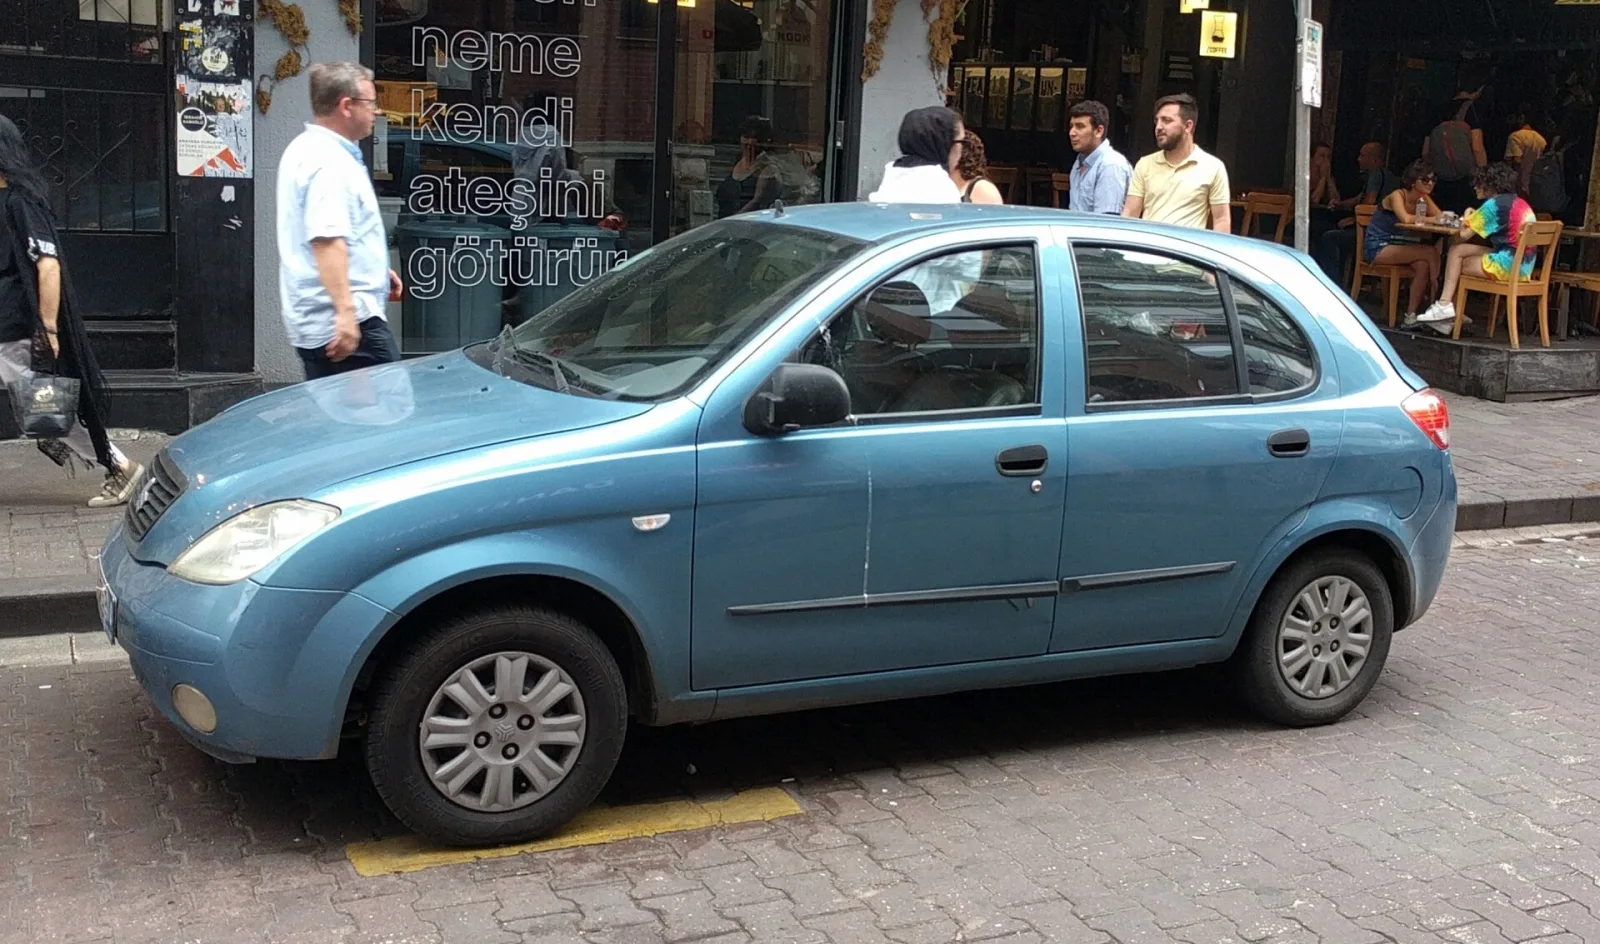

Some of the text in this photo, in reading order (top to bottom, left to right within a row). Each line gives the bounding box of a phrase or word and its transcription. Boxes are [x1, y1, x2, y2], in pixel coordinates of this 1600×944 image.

[412, 26, 581, 77] neme
[411, 89, 573, 147] kendi
[408, 167, 605, 230] ateşini
[408, 235, 628, 299] götürür
